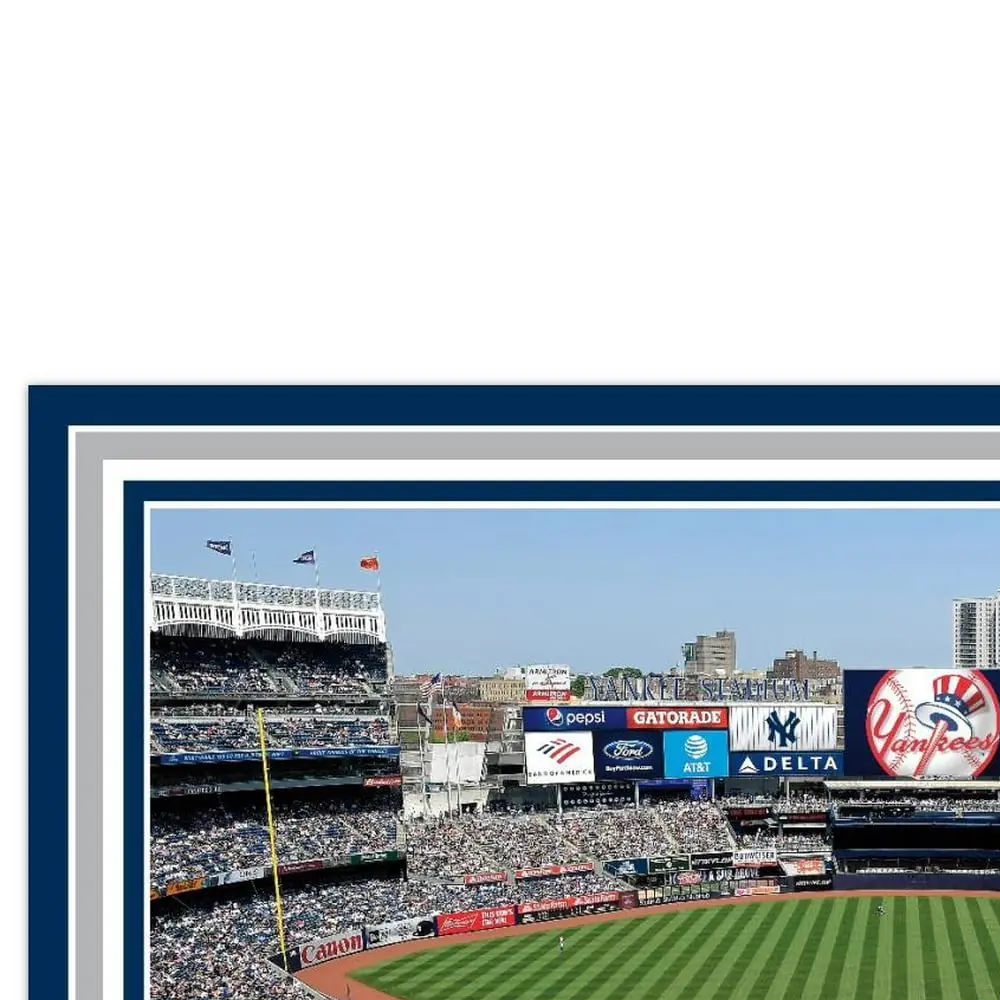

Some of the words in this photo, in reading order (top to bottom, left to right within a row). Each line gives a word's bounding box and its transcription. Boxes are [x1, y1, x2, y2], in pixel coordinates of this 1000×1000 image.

[587, 675, 684, 700] YANKEE
[701, 678, 809, 701] STADIUM
[566, 710, 605, 724] pepsi
[633, 711, 721, 724] GATORADE
[867, 698, 996, 760] Yankees
[613, 740, 643, 756] Ford
[684, 762, 711, 773] AT&T
[763, 757, 838, 771] DELTA
[301, 934, 362, 963] Canon
